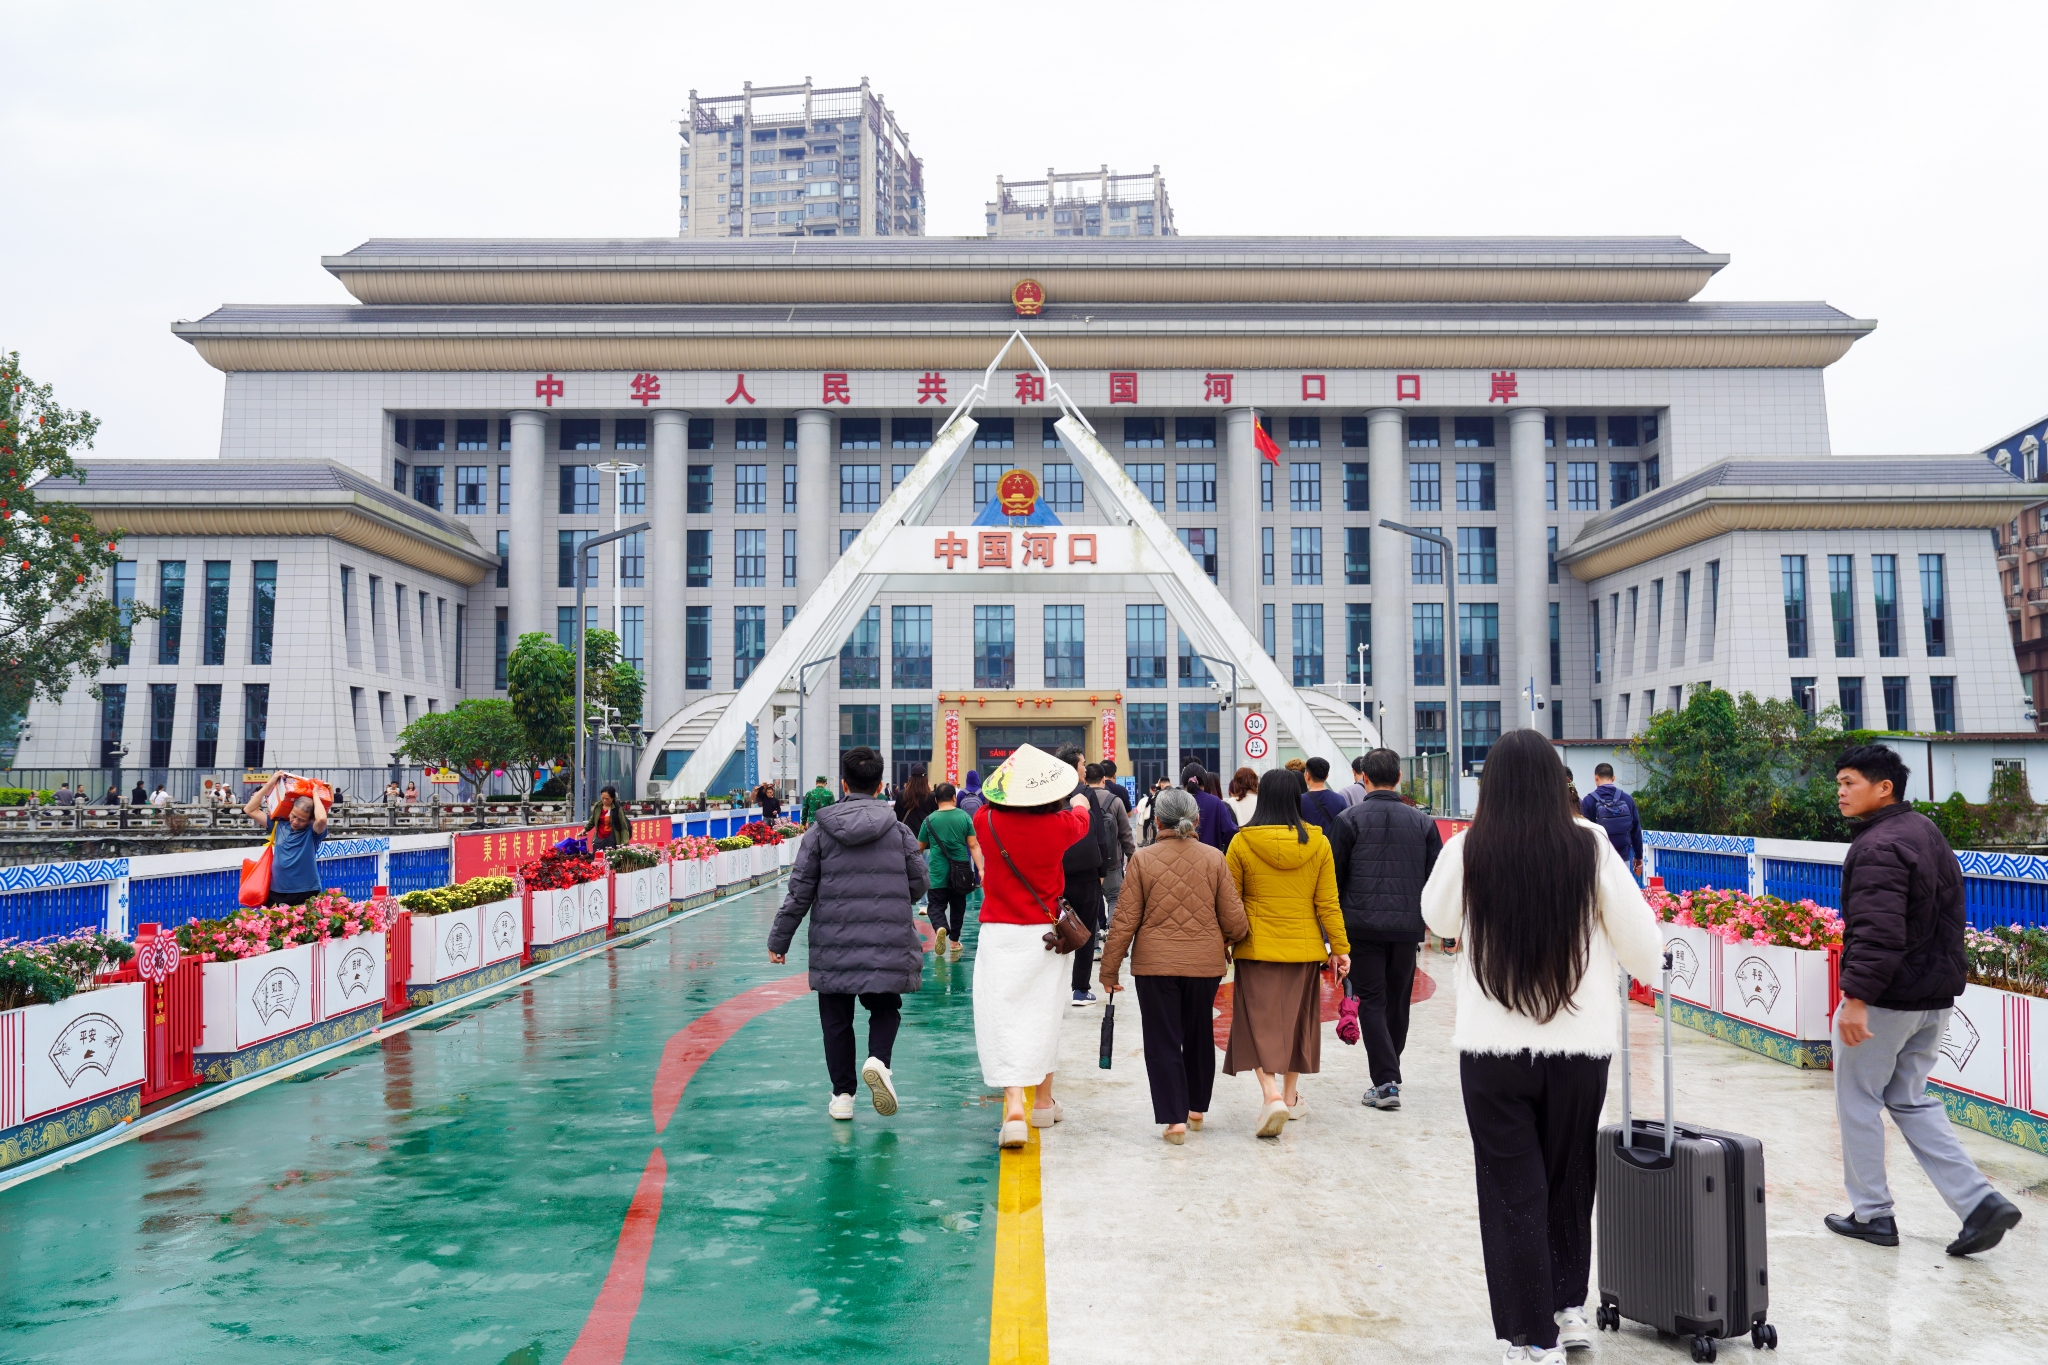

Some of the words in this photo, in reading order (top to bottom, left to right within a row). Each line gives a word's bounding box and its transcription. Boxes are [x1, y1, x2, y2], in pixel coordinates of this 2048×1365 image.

[535, 371, 1519, 406] 中华人民共和国河口口岸
[934, 531, 1098, 569] 中国河口
[154, 948, 165, 970] 福
[1751, 968, 1763, 982] 平安
[79, 1028, 97, 1045] 平安
